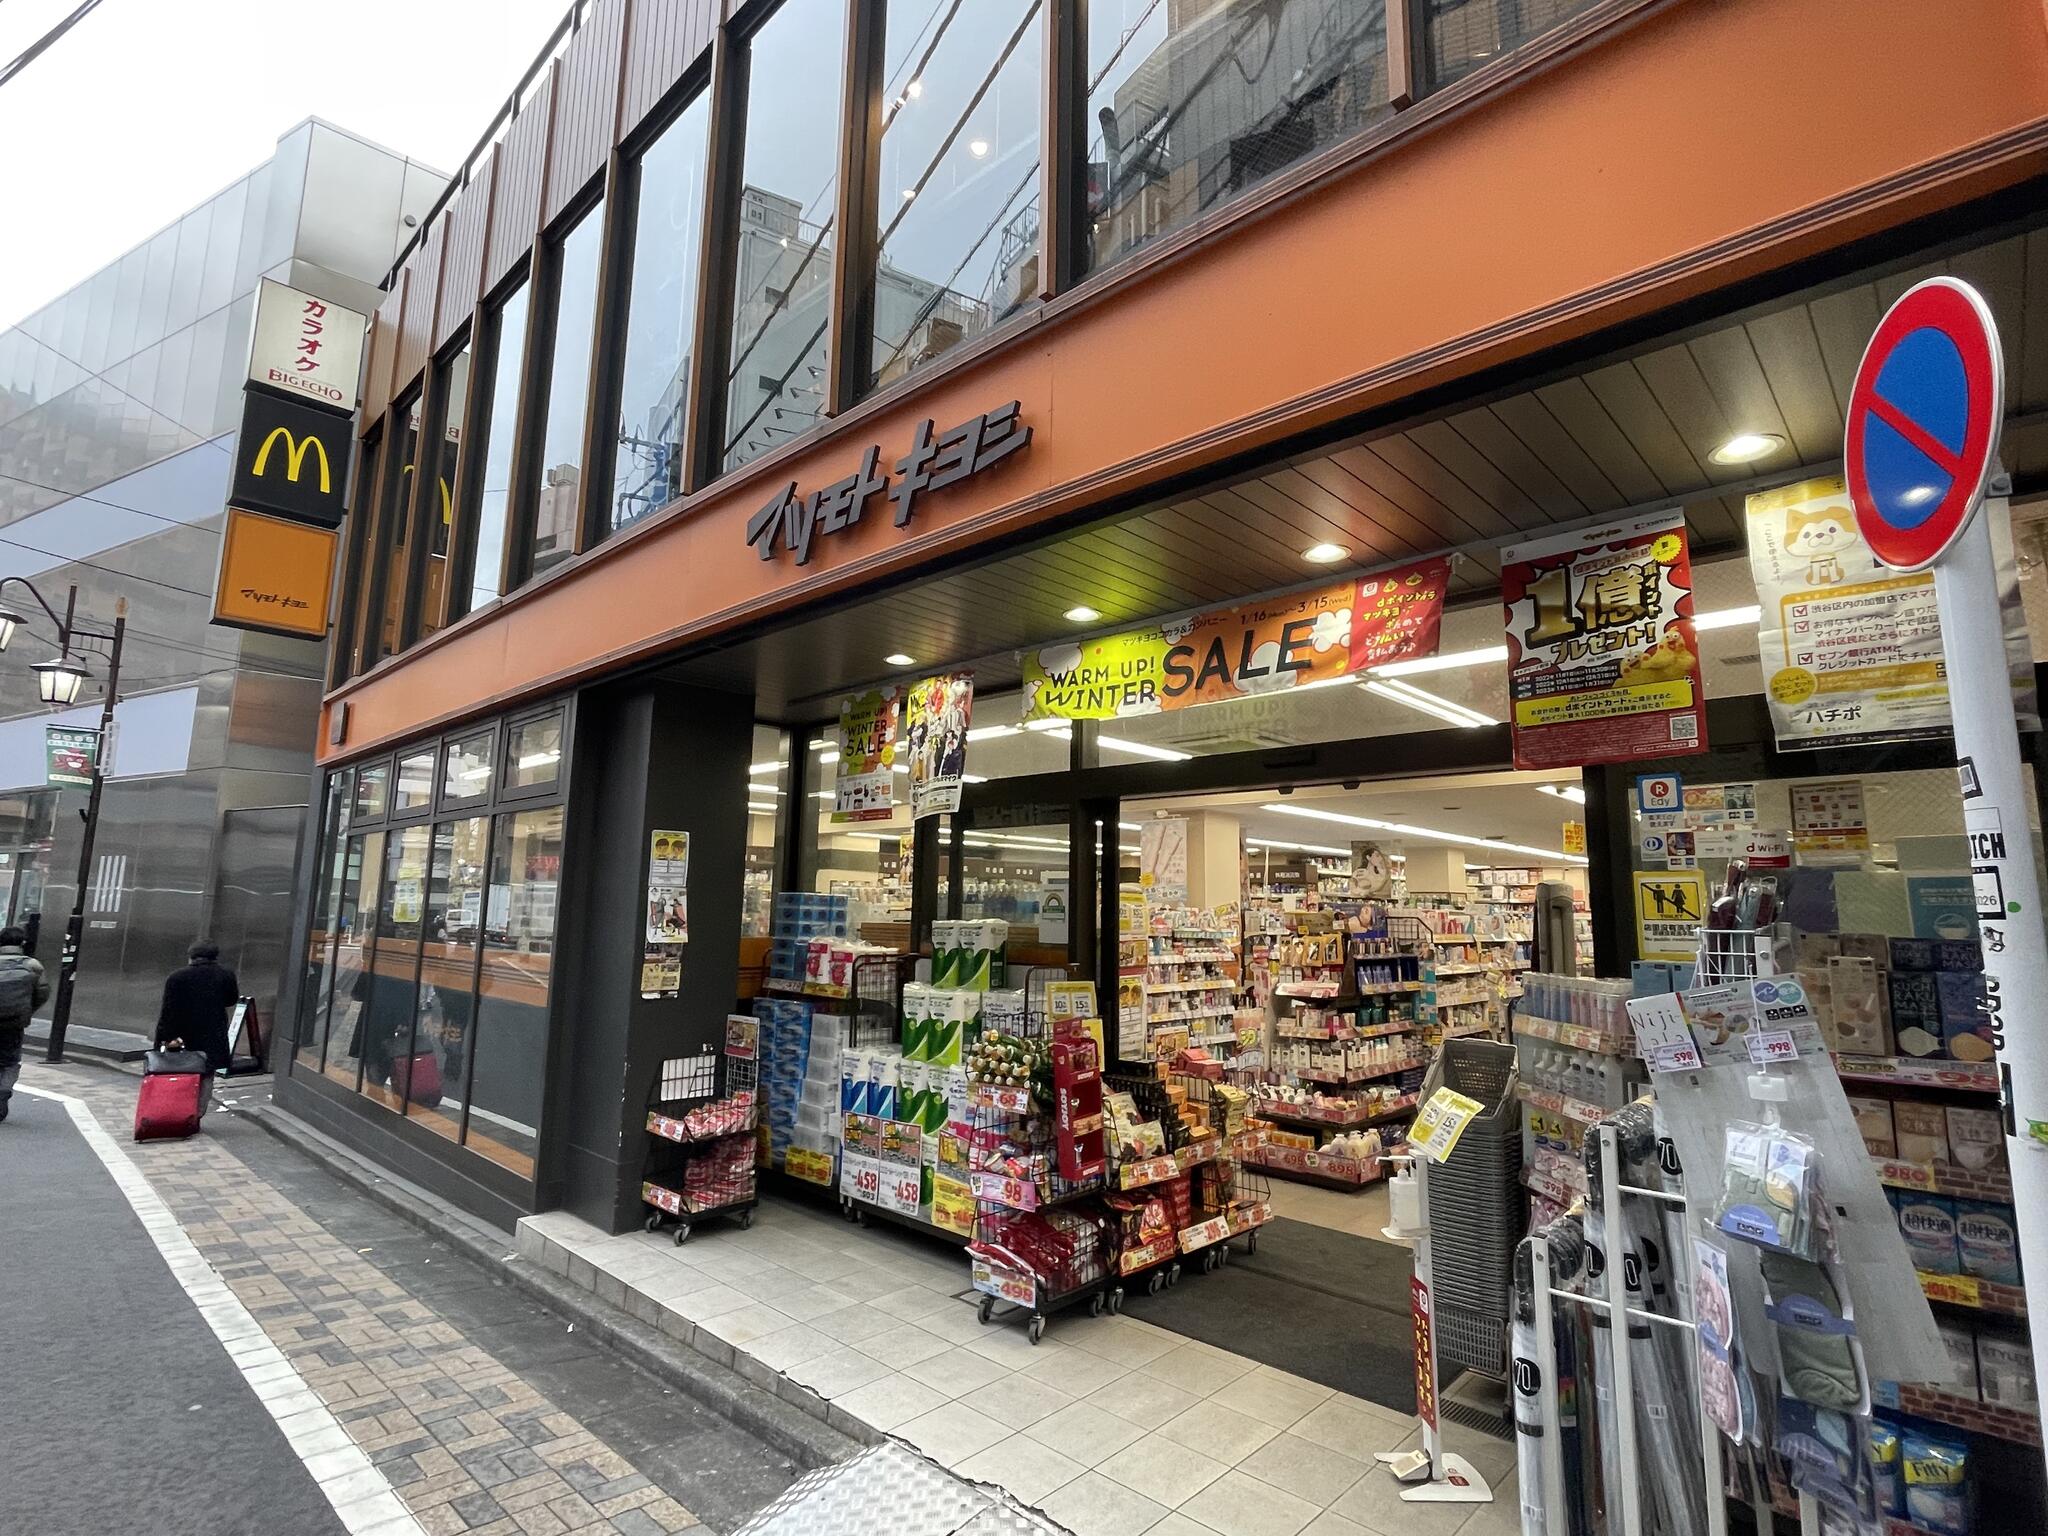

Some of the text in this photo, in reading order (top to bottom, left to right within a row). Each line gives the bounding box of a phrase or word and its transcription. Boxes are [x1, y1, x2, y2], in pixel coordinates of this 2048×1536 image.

[294, 300, 328, 373] カラオケ
[268, 368, 343, 401] BIG ECHO
[746, 399, 1034, 567] マツモトキヨシ
[1162, 617, 1319, 697] SALE
[1050, 656, 1155, 689] WARM UP!
[1045, 679, 1157, 710] WINTER
[847, 719, 887, 736] WINTER
[850, 710, 872, 721] WARM
[1806, 705, 1862, 724] ハチポ
[846, 733, 887, 757] SALE
[1651, 797, 1670, 806] Edy
[1674, 1051, 1694, 1062] 598
[1768, 1041, 1791, 1053] 998
[1059, 1087, 1070, 1131] SOYJOY
[1659, 1140, 1678, 1170] 70
[857, 1168, 877, 1191] 458
[897, 1178, 918, 1203] 458
[1515, 1361, 1531, 1392] 70
